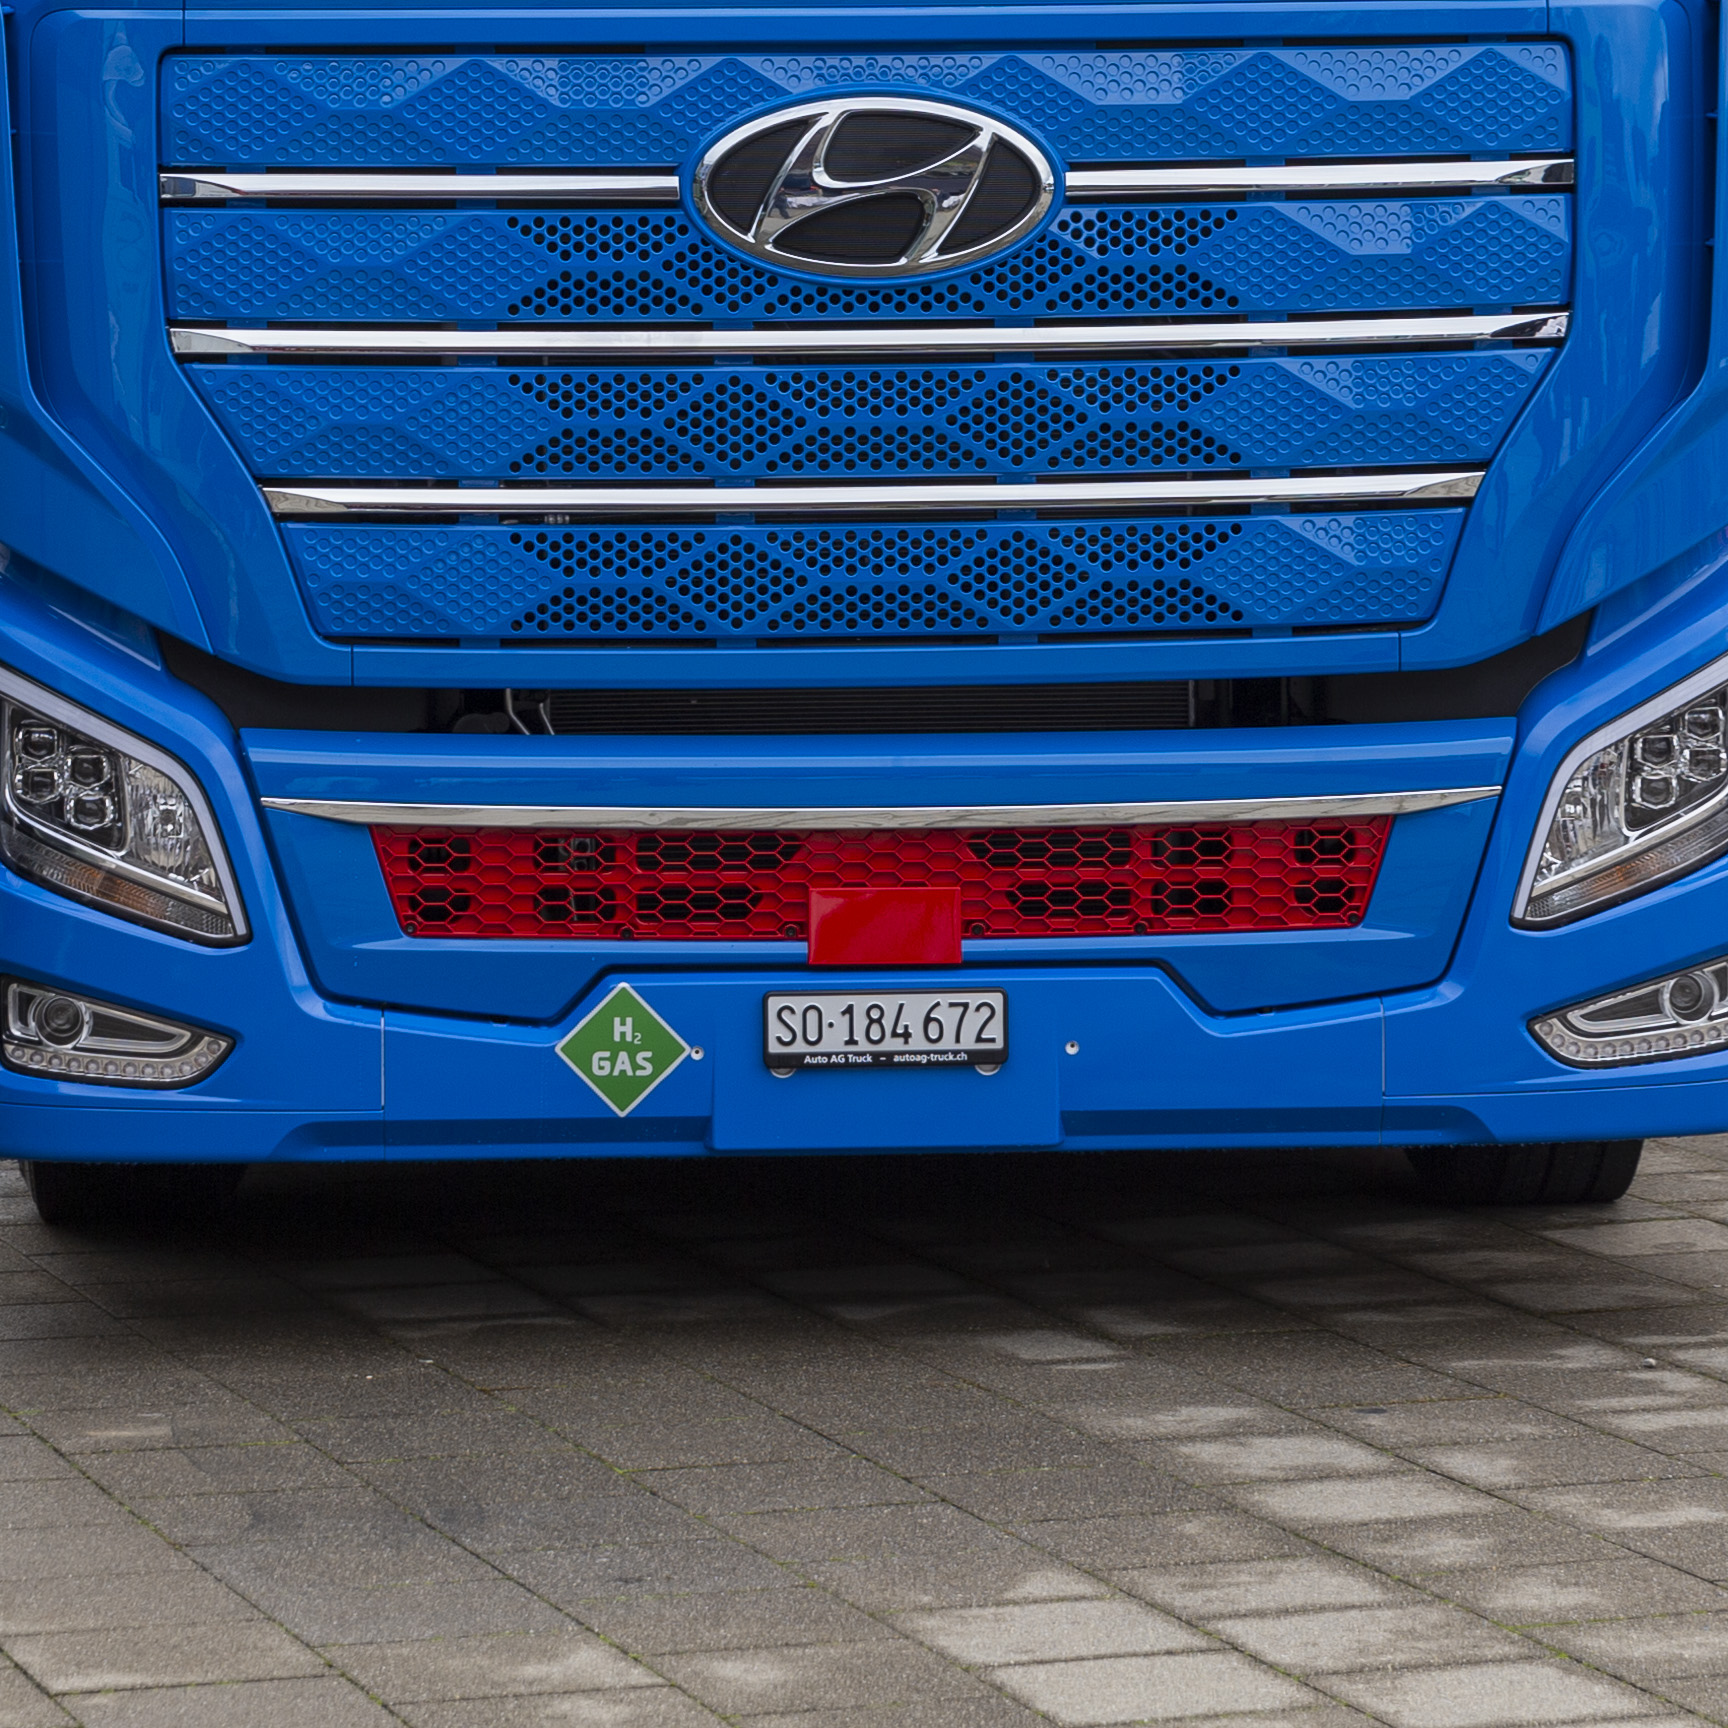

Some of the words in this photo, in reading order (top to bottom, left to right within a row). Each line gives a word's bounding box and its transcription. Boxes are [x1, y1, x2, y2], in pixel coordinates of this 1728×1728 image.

[591, 1050, 654, 1077] GAS
[803, 1054, 829, 1065] Auto
[829, 1054, 846, 1064] AG
[848, 1054, 873, 1064] Truck
[892, 1052, 969, 1064] autoag-truck.ch
